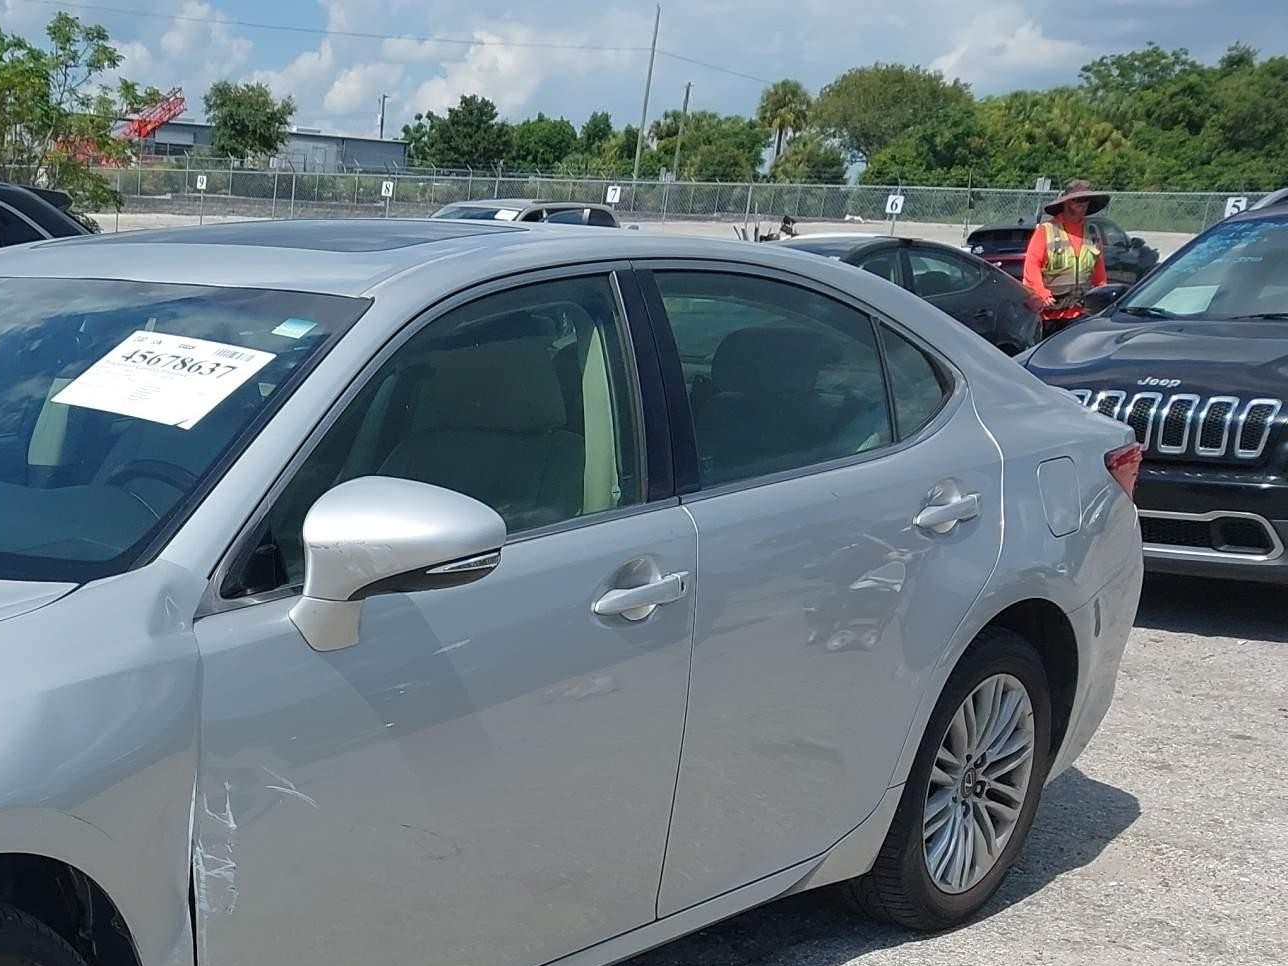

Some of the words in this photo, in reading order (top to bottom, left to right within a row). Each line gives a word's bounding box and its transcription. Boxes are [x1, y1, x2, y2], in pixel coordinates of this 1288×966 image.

[383, 183, 391, 195] 8
[610, 187, 618, 201] 7
[890, 197, 899, 212] 6
[1230, 199, 1242, 217] 5
[121, 349, 239, 379] 45678637
[1136, 376, 1182, 388] Jeep
